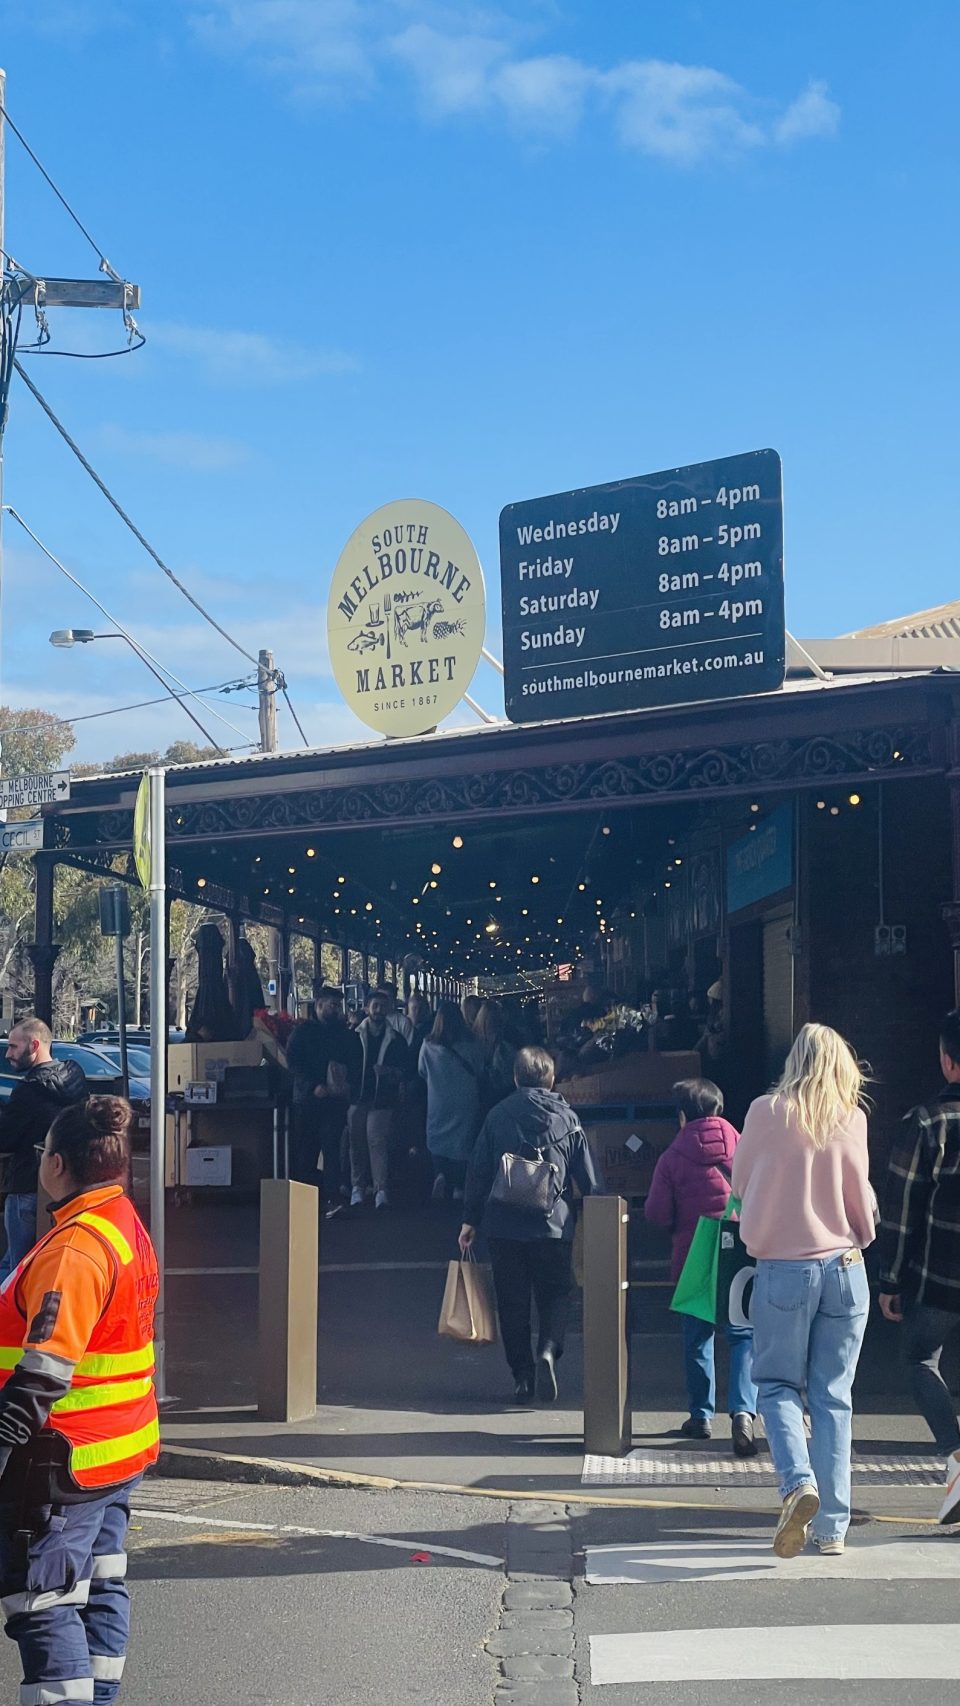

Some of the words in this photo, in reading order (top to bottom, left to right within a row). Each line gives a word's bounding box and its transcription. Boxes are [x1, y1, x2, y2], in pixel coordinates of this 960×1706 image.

[372, 524, 429, 554] SOUTH
[517, 511, 620, 545] Wednesday
[518, 557, 574, 581] Friday
[337, 548, 471, 622] MELBOURNE
[519, 588, 600, 616] Saturday
[521, 625, 586, 651] Sunday
[356, 656, 457, 693] MARKET
[522, 651, 764, 696] southmelbournemarket.com.au
[374, 700, 406, 712] SINCE
[412, 695, 438, 707] 1867
[8, 776, 53, 793] MELBOURNE
[28, 789, 56, 803] CENTRE
[2, 832, 30, 847] CECIL
[33, 829, 41, 841] ST
